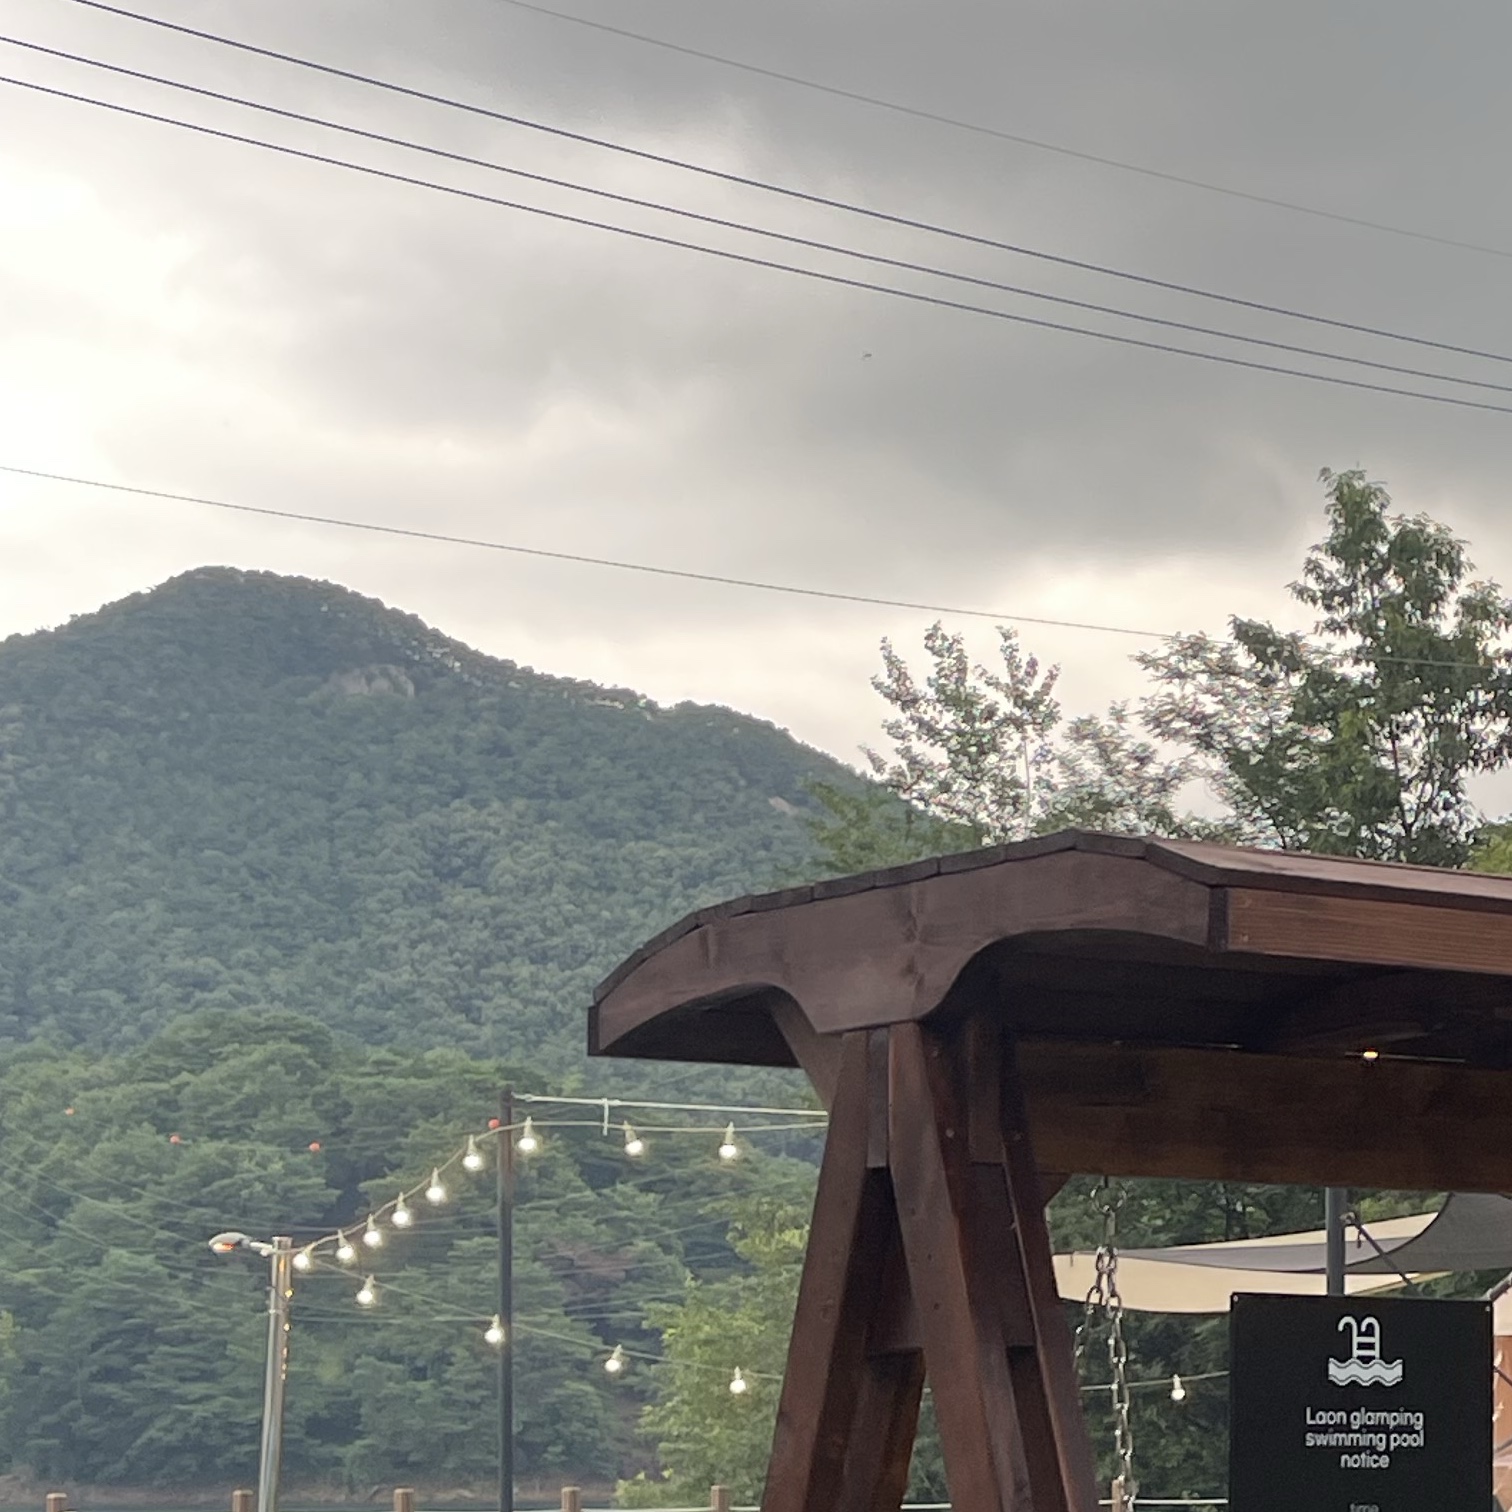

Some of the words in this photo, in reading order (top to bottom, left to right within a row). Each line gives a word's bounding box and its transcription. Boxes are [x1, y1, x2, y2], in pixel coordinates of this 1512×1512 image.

[1306, 1407, 1347, 1425] Laon
[1350, 1407, 1424, 1430] glamping
[1305, 1429, 1387, 1450] swimming
[1390, 1430, 1424, 1450] pool
[1340, 1450, 1390, 1468] notice
